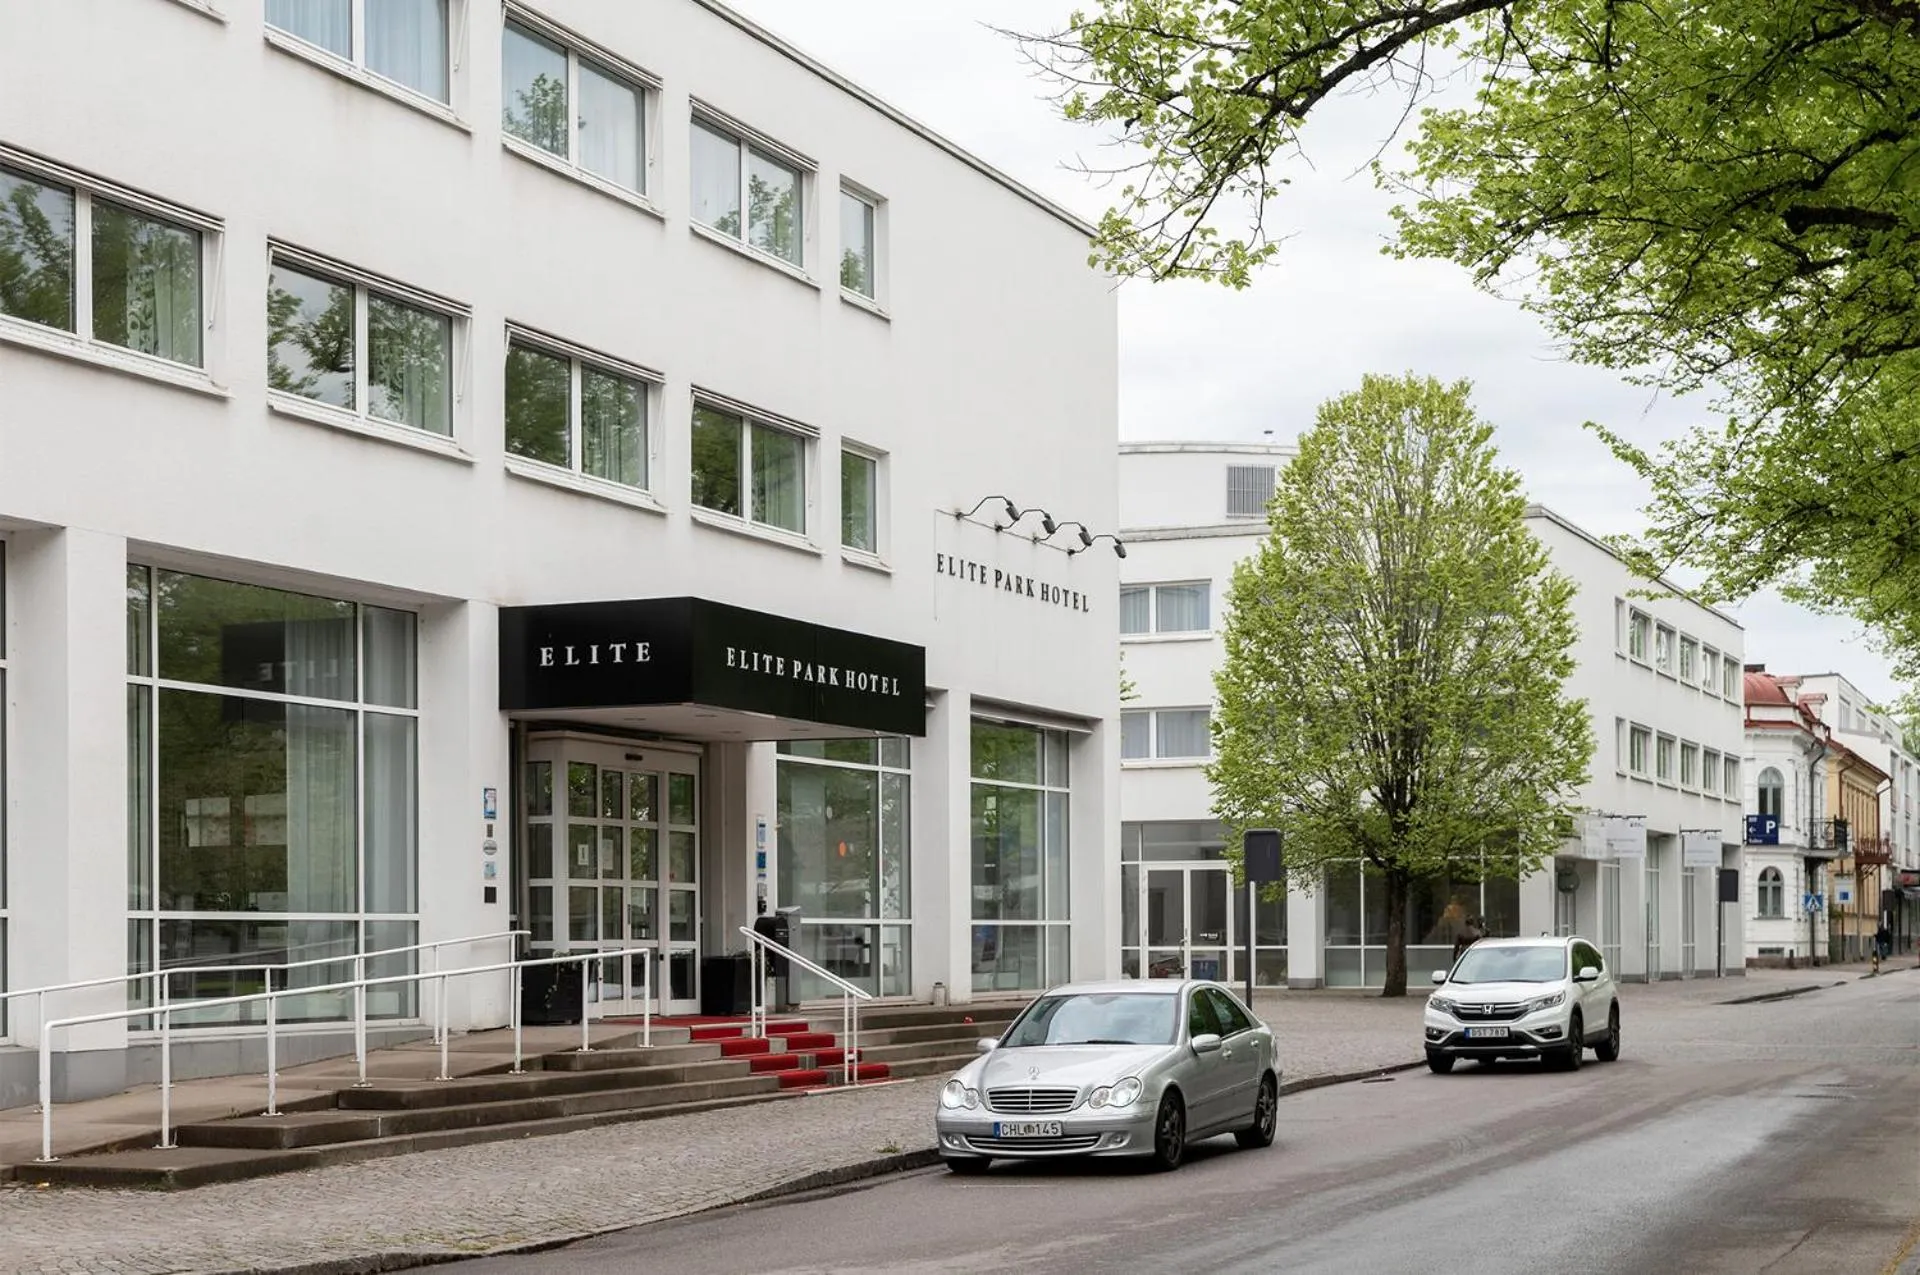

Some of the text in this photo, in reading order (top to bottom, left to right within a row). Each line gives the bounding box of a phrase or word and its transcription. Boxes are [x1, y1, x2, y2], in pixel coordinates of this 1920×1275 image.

[936, 553, 1090, 613] ELITE PARK HOTEL
[540, 641, 652, 667] ELITE
[726, 646, 901, 696] ELITE PARK HOTEL
[1766, 820, 1776, 834] P
[1001, 1123, 1059, 1136] CHL 145
